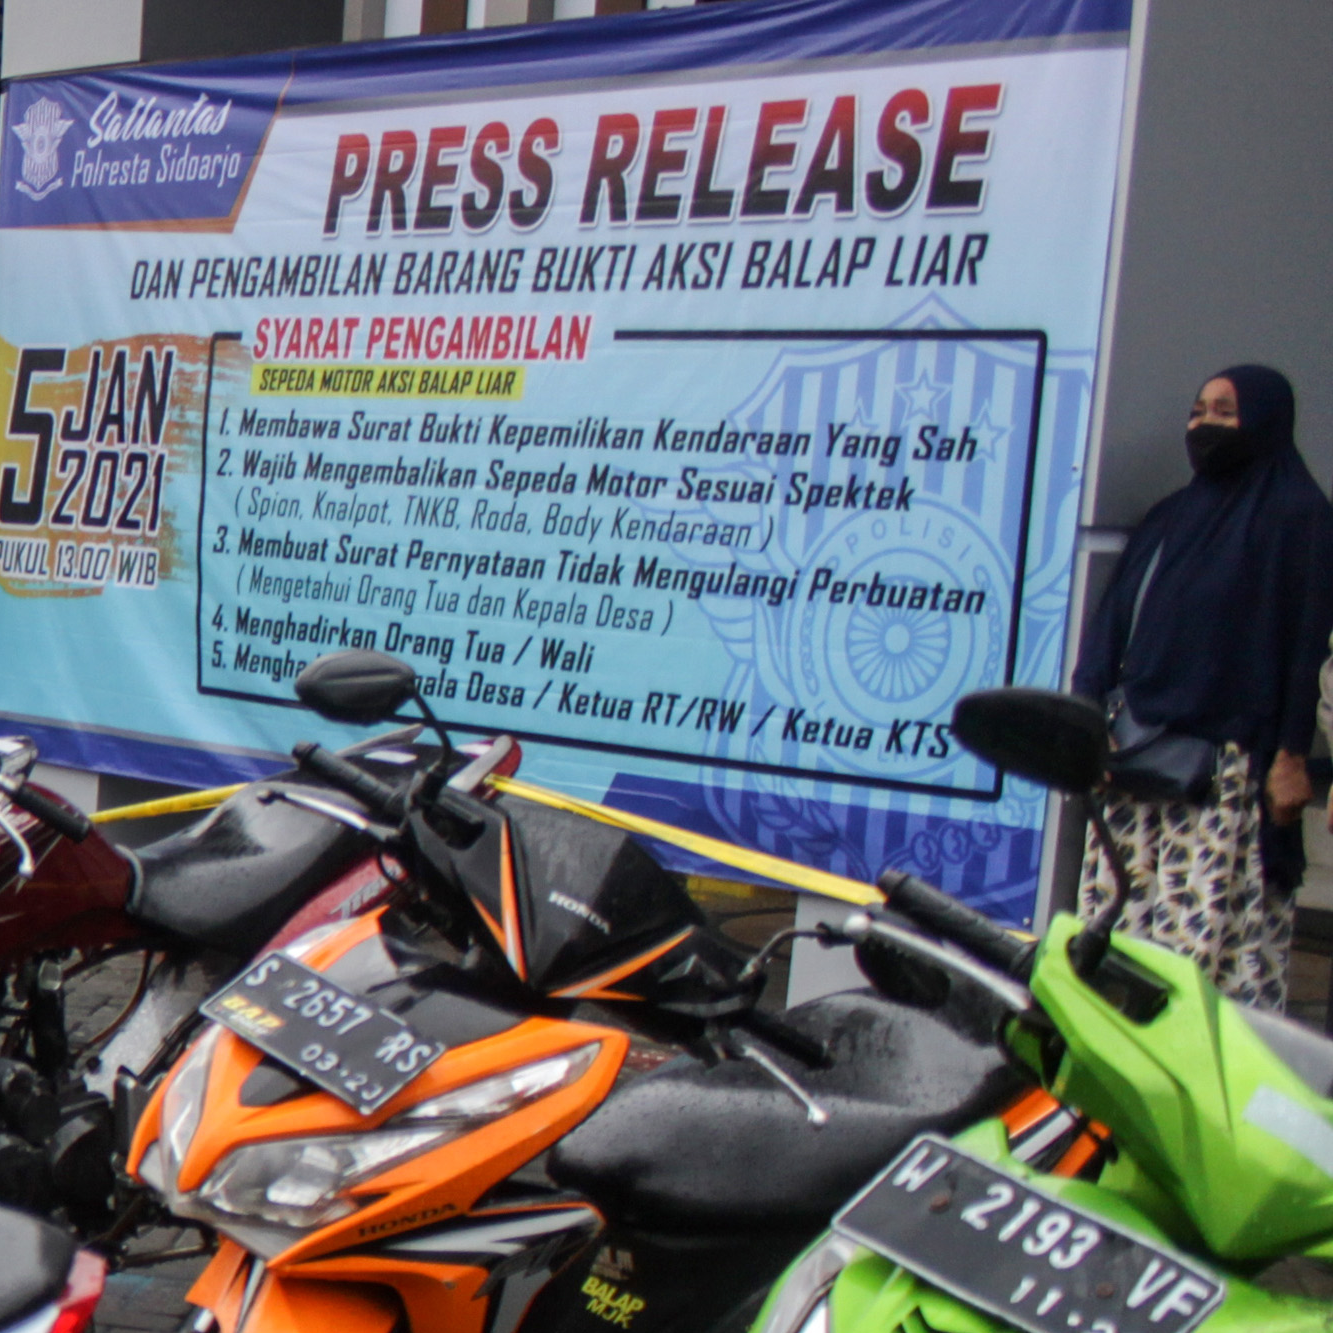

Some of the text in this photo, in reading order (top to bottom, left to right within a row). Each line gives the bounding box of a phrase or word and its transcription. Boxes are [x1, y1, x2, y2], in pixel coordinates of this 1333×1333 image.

[87, 91, 231, 149] Satlantas
[71, 146, 241, 189] Polresta Sidoarjo
[323, 83, 1003, 236] PRESS RELEASE
[131, 233, 990, 299] DAN PENGAMBILAN BARANG BUKTI AKSI BALAP LIAR
[253, 315, 592, 361] SYARAT PENGAMBILAN
[60, 349, 175, 445] JAN
[259, 368, 516, 395] SEPEDA MOTOR AKSI BALAP LIAR
[219, 408, 978, 466] 1. Membawa Surat Bukti Kepemilikan Kendaraan Yang Sah
[51, 450, 166, 532] 2021
[217, 448, 915, 513] 2. Wajib Mengembalikan Sepeda Motor Sesuai Spektek
[542, 503, 603, 545] Body
[610, 507, 752, 548] Kendaraan
[55, 541, 112, 581] 13.00
[117, 548, 159, 586] WIB
[213, 525, 986, 615] 3. Membuat Surat Pernyataan Tidak Mengulangi Perbuatan
[249, 565, 352, 605] Mengetahui
[357, 574, 417, 616] Orang
[427, 579, 459, 613] Tua
[466, 584, 505, 617] dan
[513, 587, 588, 628] Kepala
[595, 594, 654, 631] Desa
[212, 603, 228, 632] 4.
[236, 606, 377, 650] Menghadirkan
[384, 622, 454, 665] Orang
[466, 629, 505, 664] Tua
[540, 637, 595, 674] Wali
[212, 640, 226, 669] 5.
[234, 644, 308, 684] Mengha
[467, 671, 525, 707] Desa
[558, 683, 632, 720] Ketua
[642, 691, 746, 735] RT/RW
[783, 706, 874, 750] Ketua
[548, 890, 611, 935] HONDA
[244, 958, 281, 987] S
[282, 979, 374, 1036] 2657
[374, 1030, 432, 1073] RS
[358, 1202, 458, 1238] HONDA
[893, 1146, 1210, 1322] W 2193 VF
[581, 1276, 647, 1316] BALAP
[585, 1298, 634, 1330] MJK
